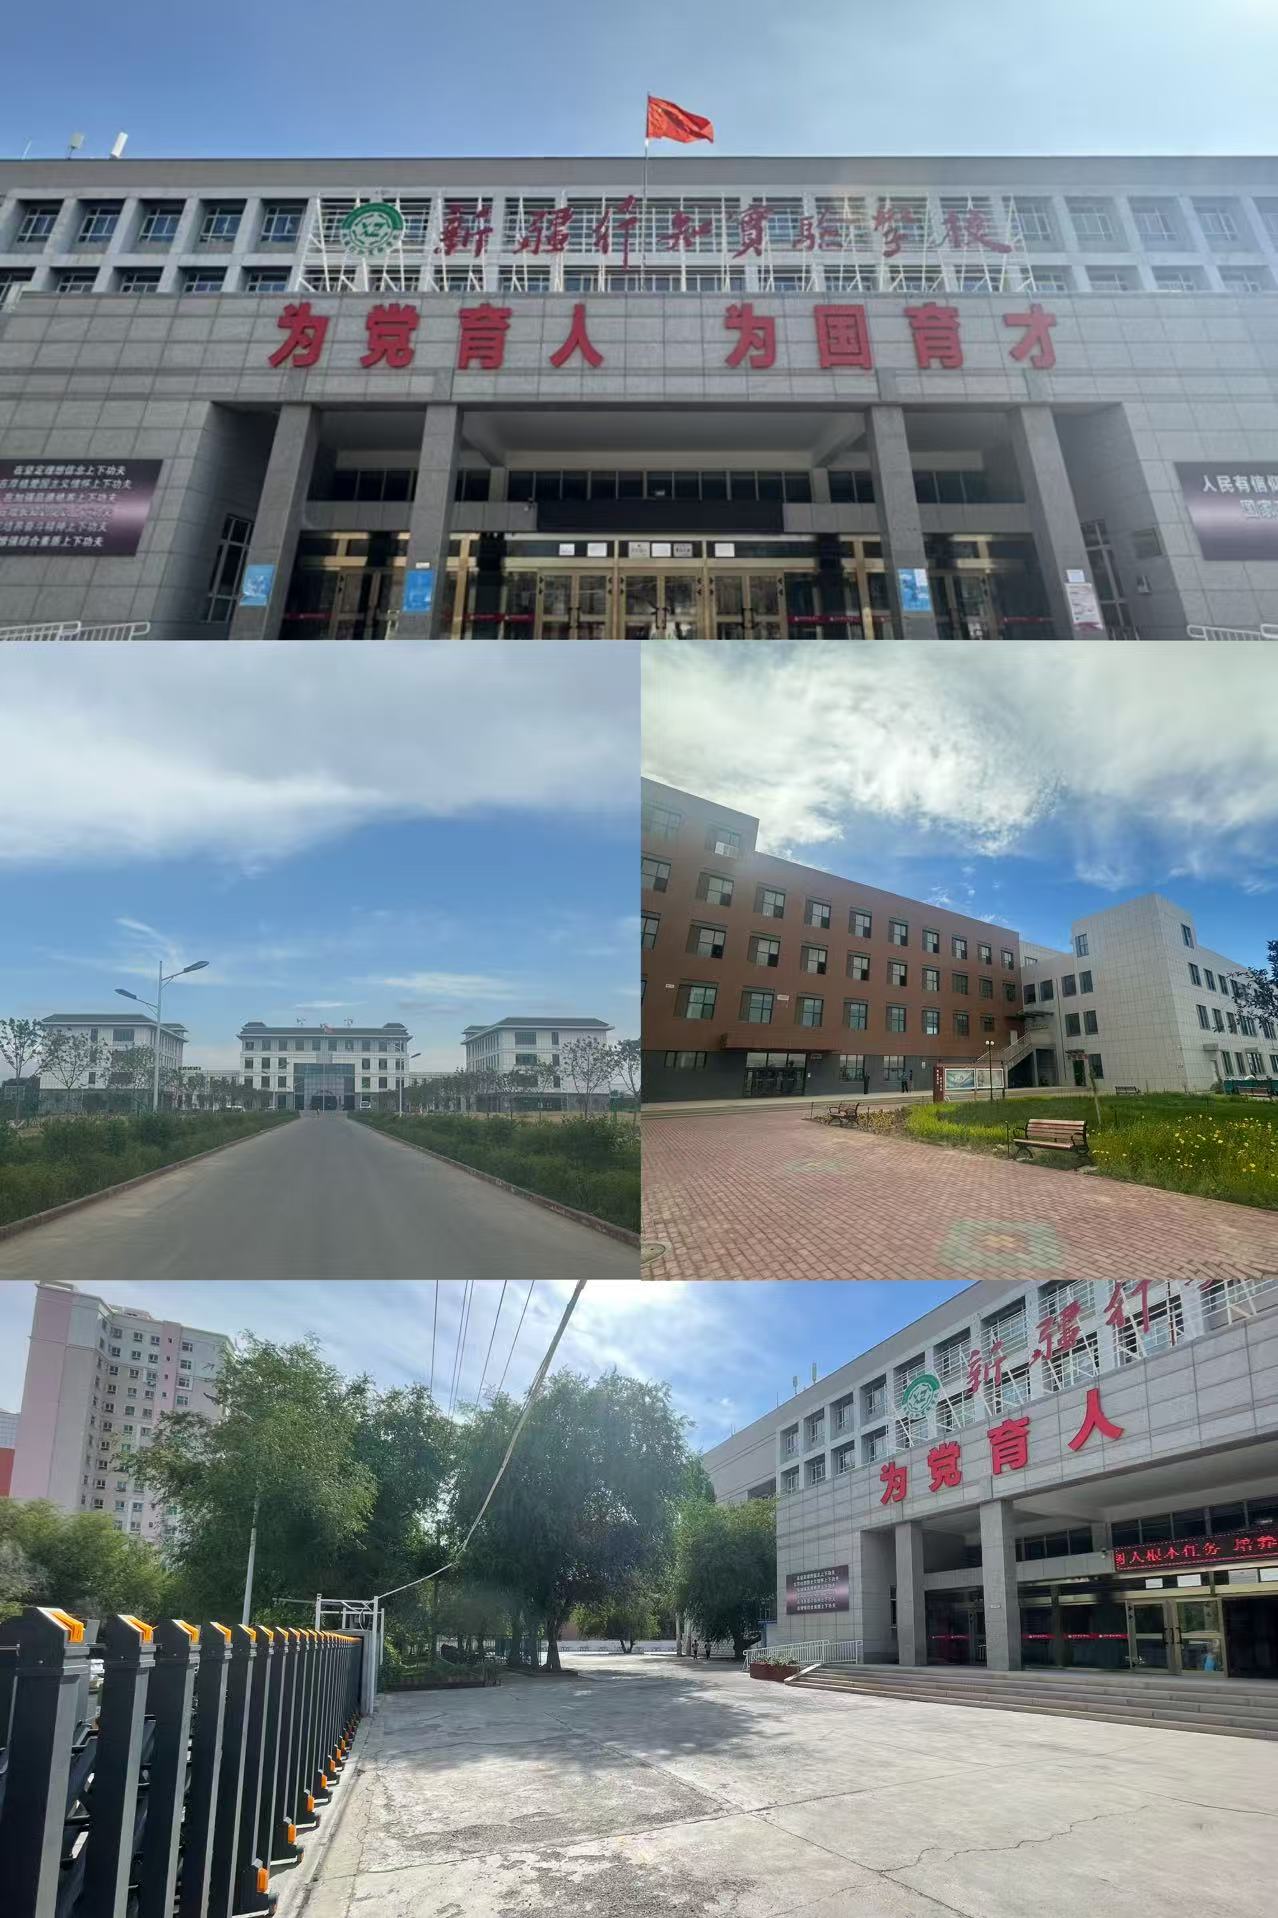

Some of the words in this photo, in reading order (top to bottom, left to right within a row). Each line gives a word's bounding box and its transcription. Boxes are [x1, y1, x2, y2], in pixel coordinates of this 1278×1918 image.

[268, 302, 604, 369] 为党育人
[724, 302, 1056, 369] 为国育才
[880, 1388, 1125, 1505] 为党育人
